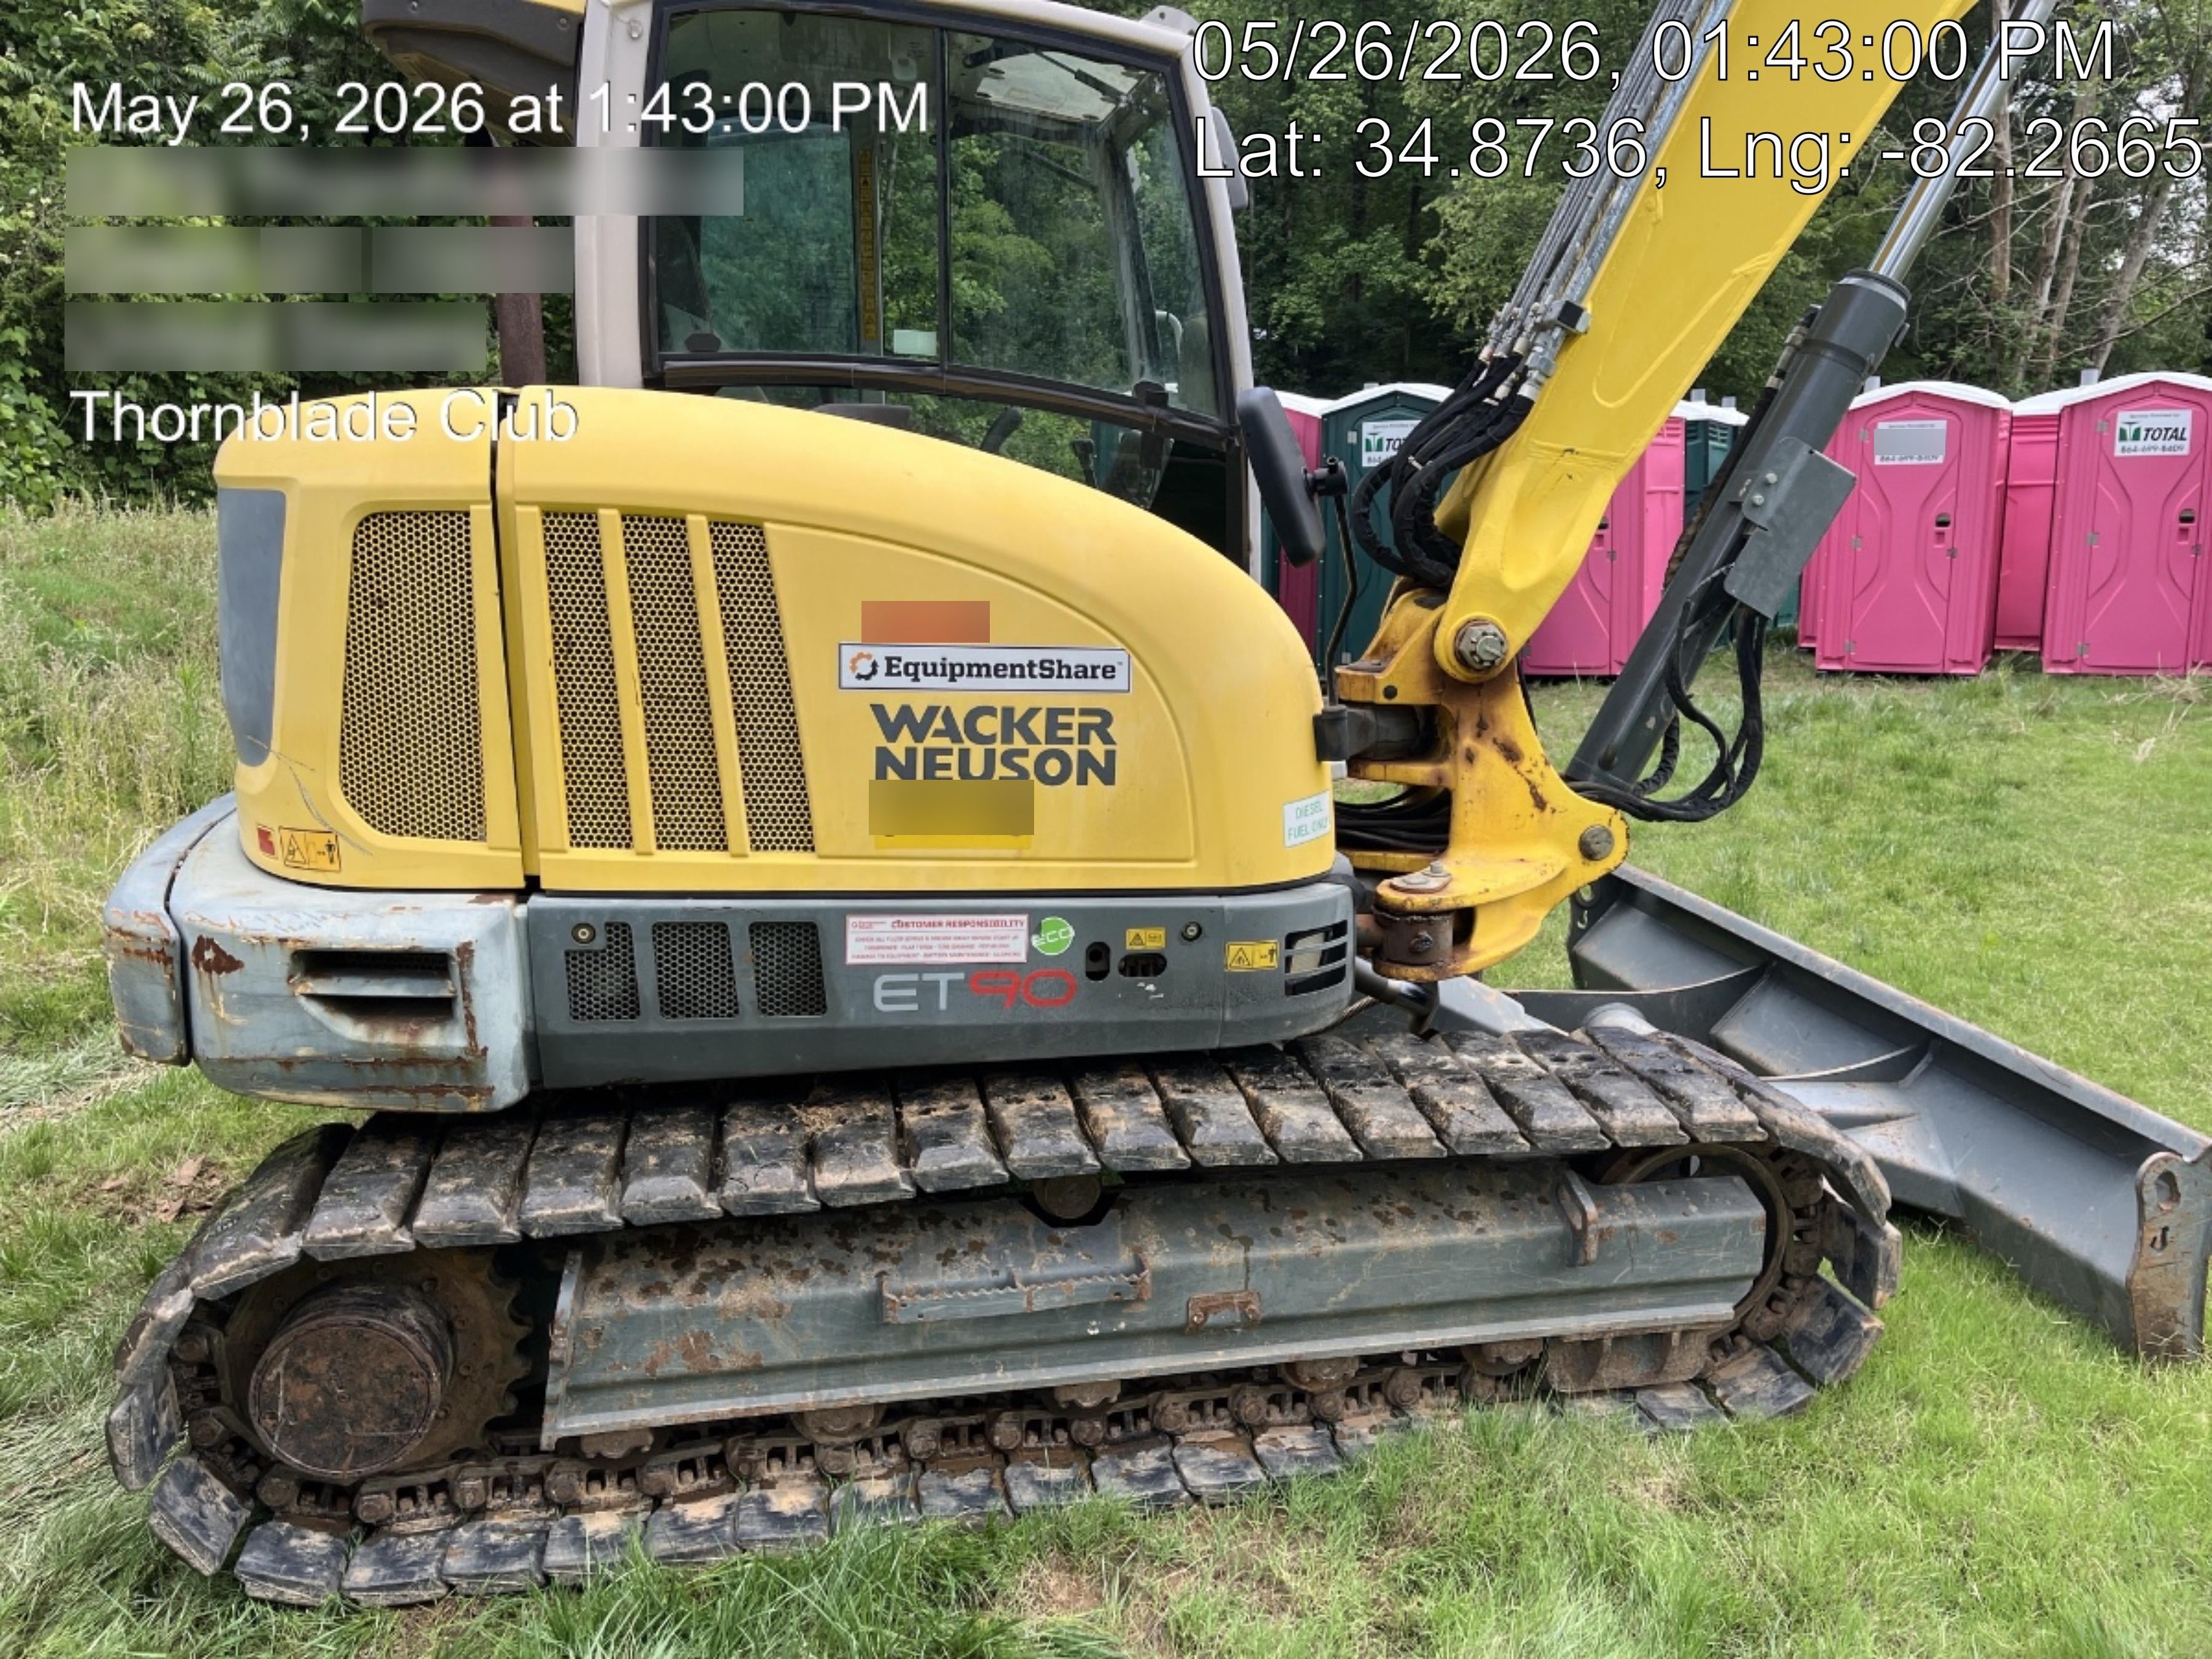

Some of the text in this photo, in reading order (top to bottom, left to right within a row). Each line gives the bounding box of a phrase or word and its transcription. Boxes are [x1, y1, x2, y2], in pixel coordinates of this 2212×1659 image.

[2143, 427, 2187, 441] TOTAL
[869, 704, 1117, 746] WACKER
[875, 746, 1116, 786] NEUSON
[1295, 800, 1324, 820] DIESEL
[1287, 823, 1311, 841] FUEL
[891, 920, 944, 928] CUSTOMER
[946, 919, 1024, 928] RESPONSIBILITY
[873, 969, 1078, 1013] ET90
